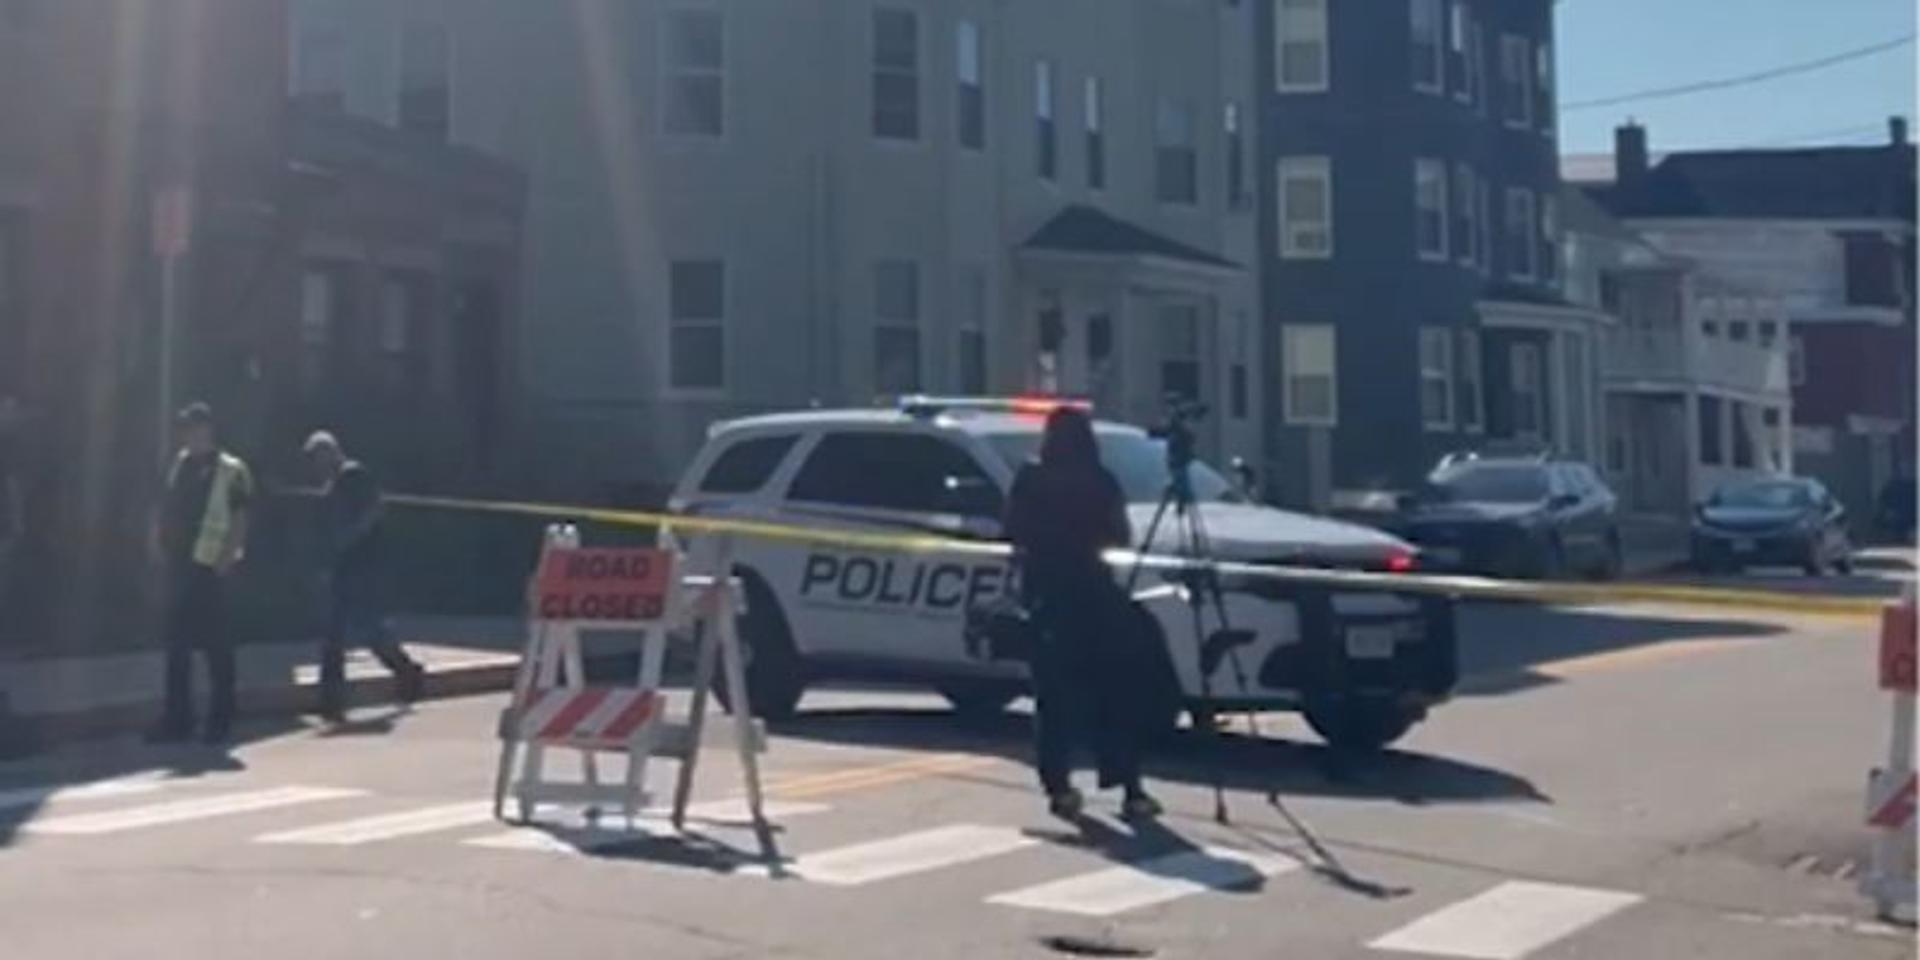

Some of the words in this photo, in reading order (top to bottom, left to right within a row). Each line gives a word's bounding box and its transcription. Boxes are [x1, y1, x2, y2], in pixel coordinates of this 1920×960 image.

[566, 554, 651, 578] ROAD
[799, 553, 1004, 609] POLICE
[540, 592, 664, 620] CLOSED
